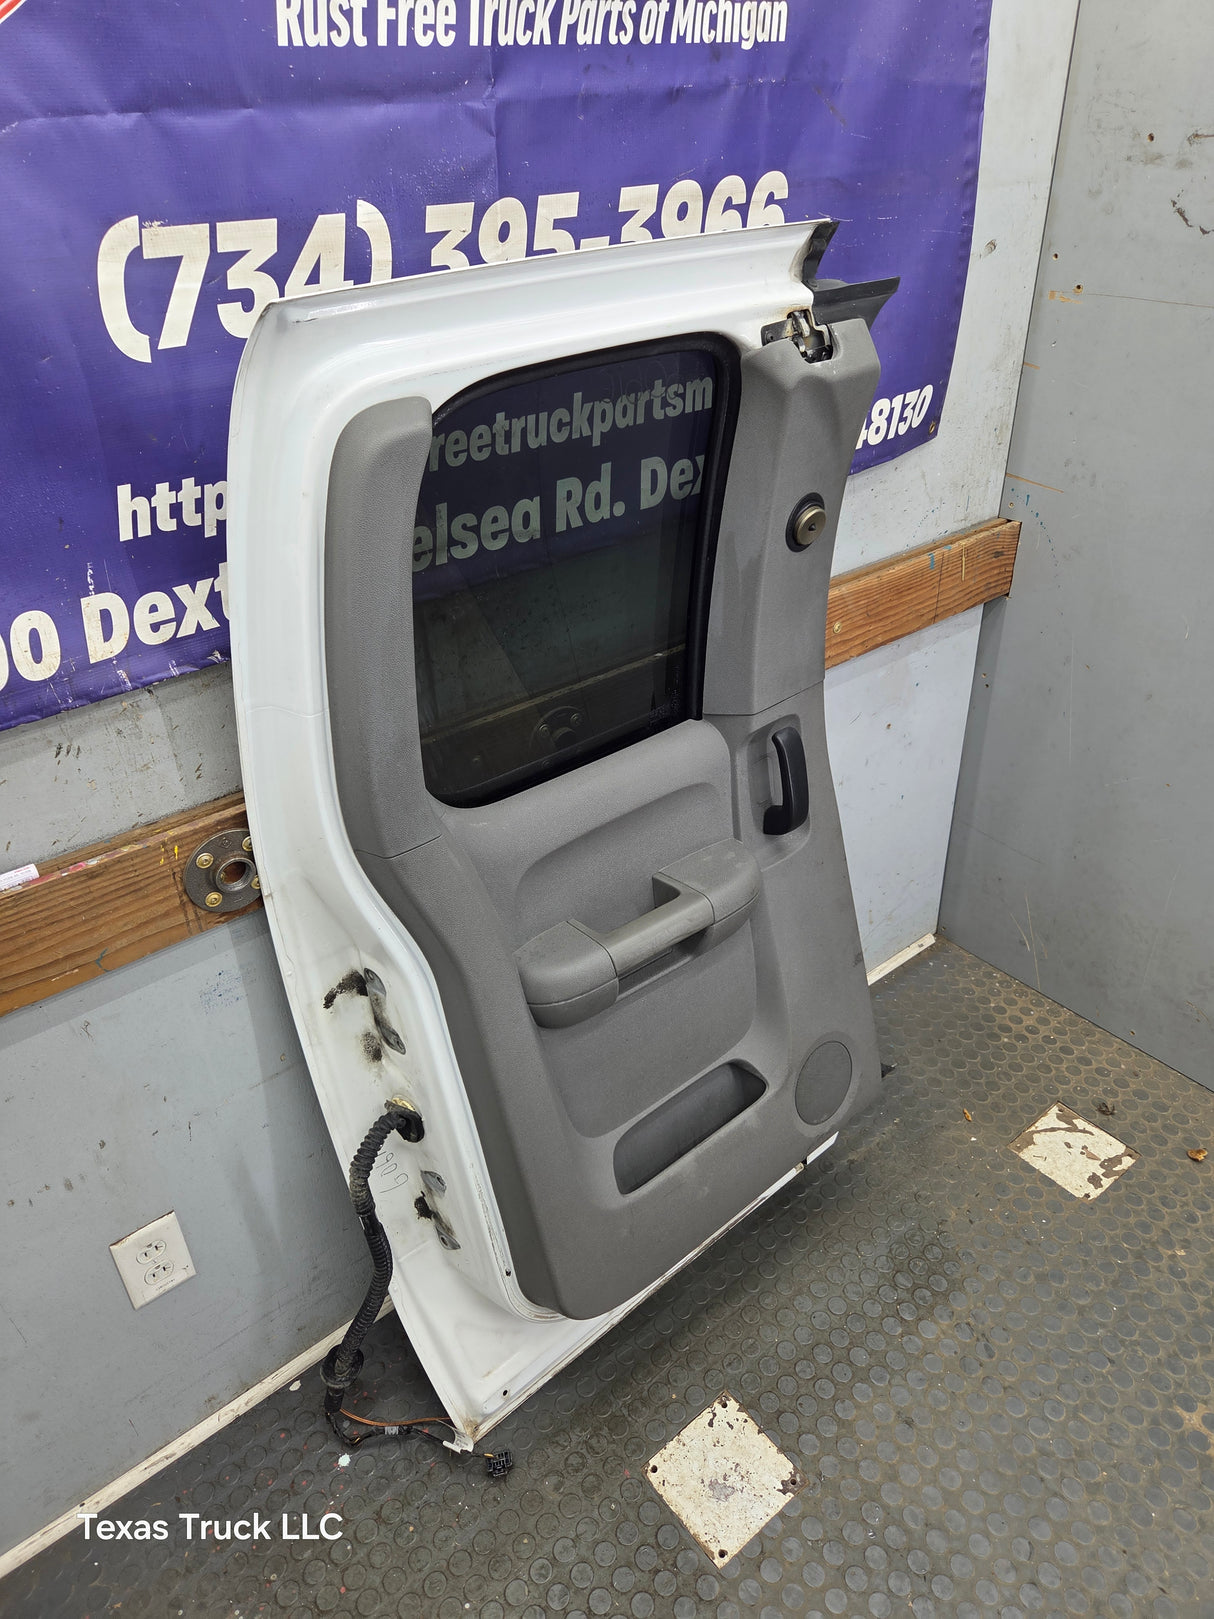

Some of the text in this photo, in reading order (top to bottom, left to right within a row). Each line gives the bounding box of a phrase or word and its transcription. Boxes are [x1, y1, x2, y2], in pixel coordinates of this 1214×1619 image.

[276, 0, 788, 50] Rust Free Truck Parts of Michigan
[0, 610, 61, 692] 0
[555, 462, 626, 533] Rd.
